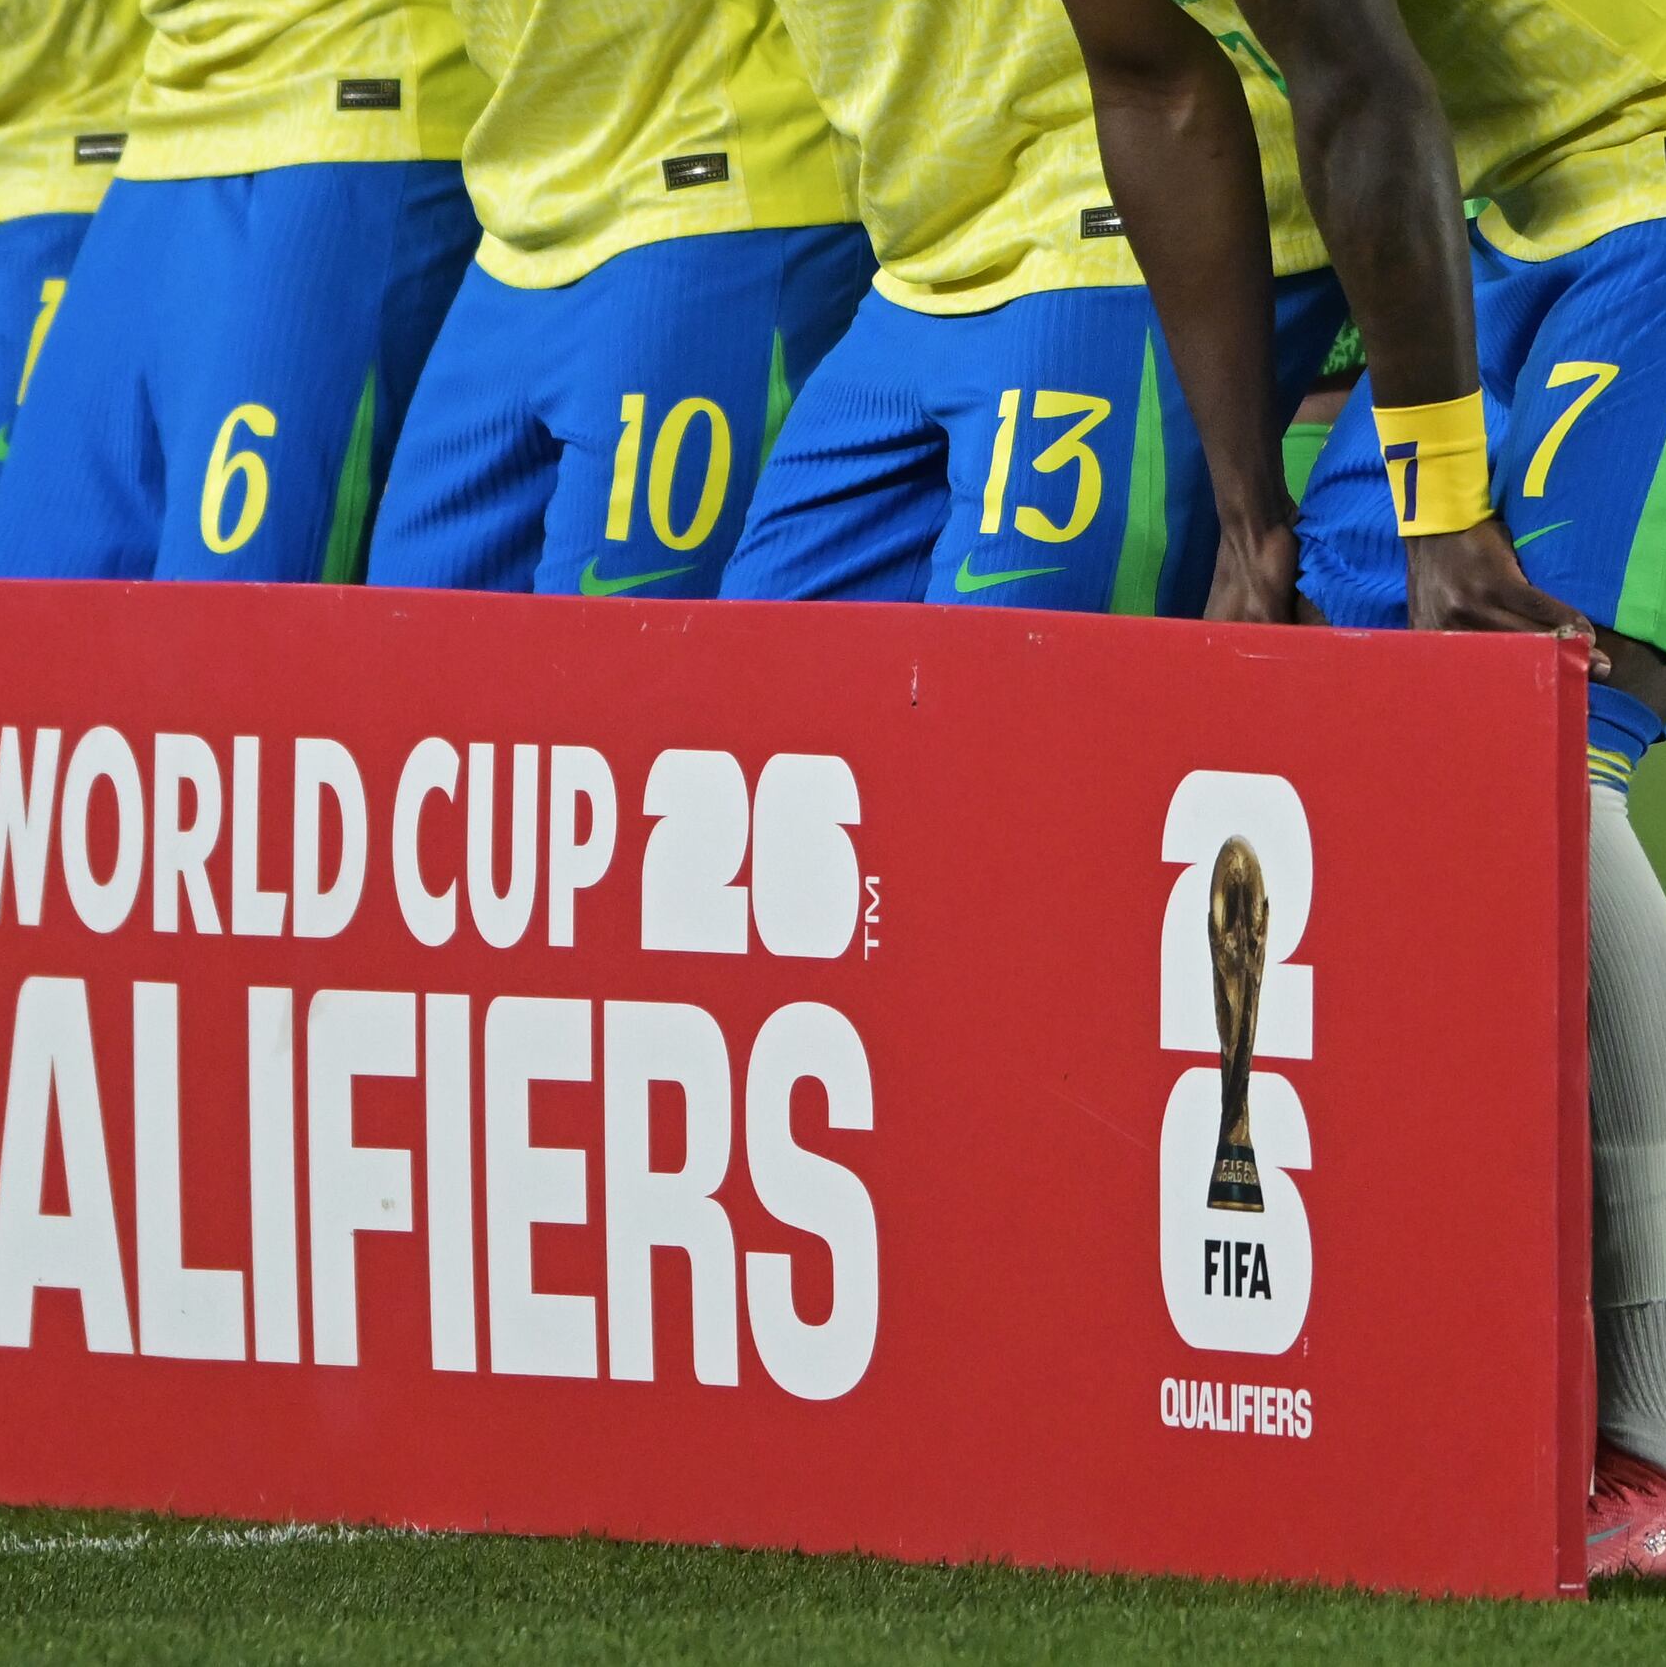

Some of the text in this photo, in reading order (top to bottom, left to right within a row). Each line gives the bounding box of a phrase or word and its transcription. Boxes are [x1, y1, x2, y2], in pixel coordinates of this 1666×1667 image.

[1215, 30, 1289, 99] 7
[200, 403, 276, 554] 6
[605, 392, 731, 551] 10
[981, 389, 1111, 543] 13
[1384, 441, 1419, 523] 7
[1524, 360, 1620, 497] 7
[393, 736, 618, 949] CUP
[641, 748, 862, 959] 26
[1204, 1239, 1272, 1300] FIFA
[1160, 1377, 1313, 1439] QUALIFIERS
